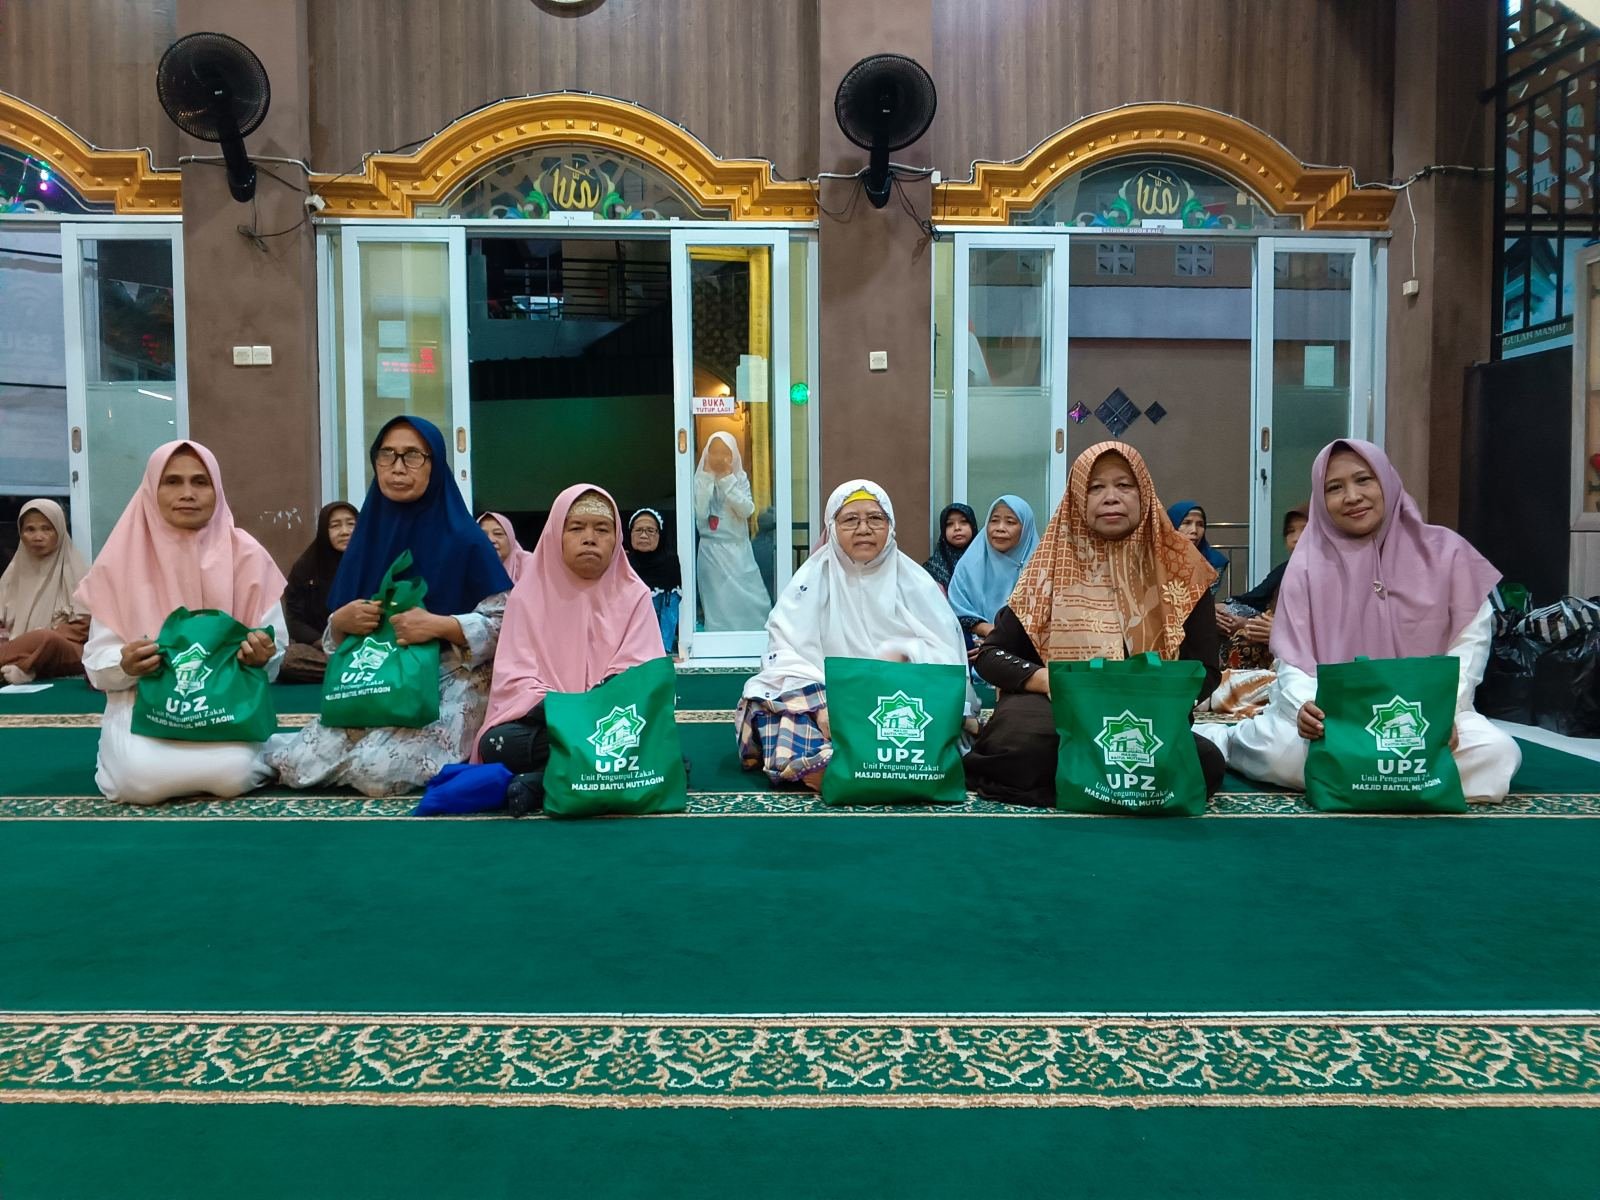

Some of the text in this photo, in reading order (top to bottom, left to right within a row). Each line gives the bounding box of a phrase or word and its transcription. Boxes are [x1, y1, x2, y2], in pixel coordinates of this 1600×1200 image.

[702, 399, 725, 407] BUKA
[340, 670, 376, 684] UPZ
[358, 686, 391, 696] MUTTAQIN
[165, 696, 209, 715] UPZ
[204, 707, 226, 718] Zakat
[194, 714, 235, 728] MUTAQIN
[877, 748, 925, 764] UPZ
[595, 755, 640, 773] UPZ
[863, 762, 939, 772] Unit Pengumpul Zakat
[1377, 758, 1427, 775] UPZ
[596, 773, 633, 782] Pengumpul
[634, 769, 655, 779] Zakat
[855, 771, 881, 779] MASJID
[882, 772, 907, 780] BAITUL
[1106, 773, 1156, 791] UPZ
[1361, 774, 1378, 782] Unit
[1379, 774, 1420, 783] Pengumpul
[571, 776, 665, 791] MASJID BAITUL MUTTAQIN
[1095, 781, 1110, 793] Unit
[1352, 783, 1381, 791] MASJID
[1084, 786, 1110, 803] MASJID
